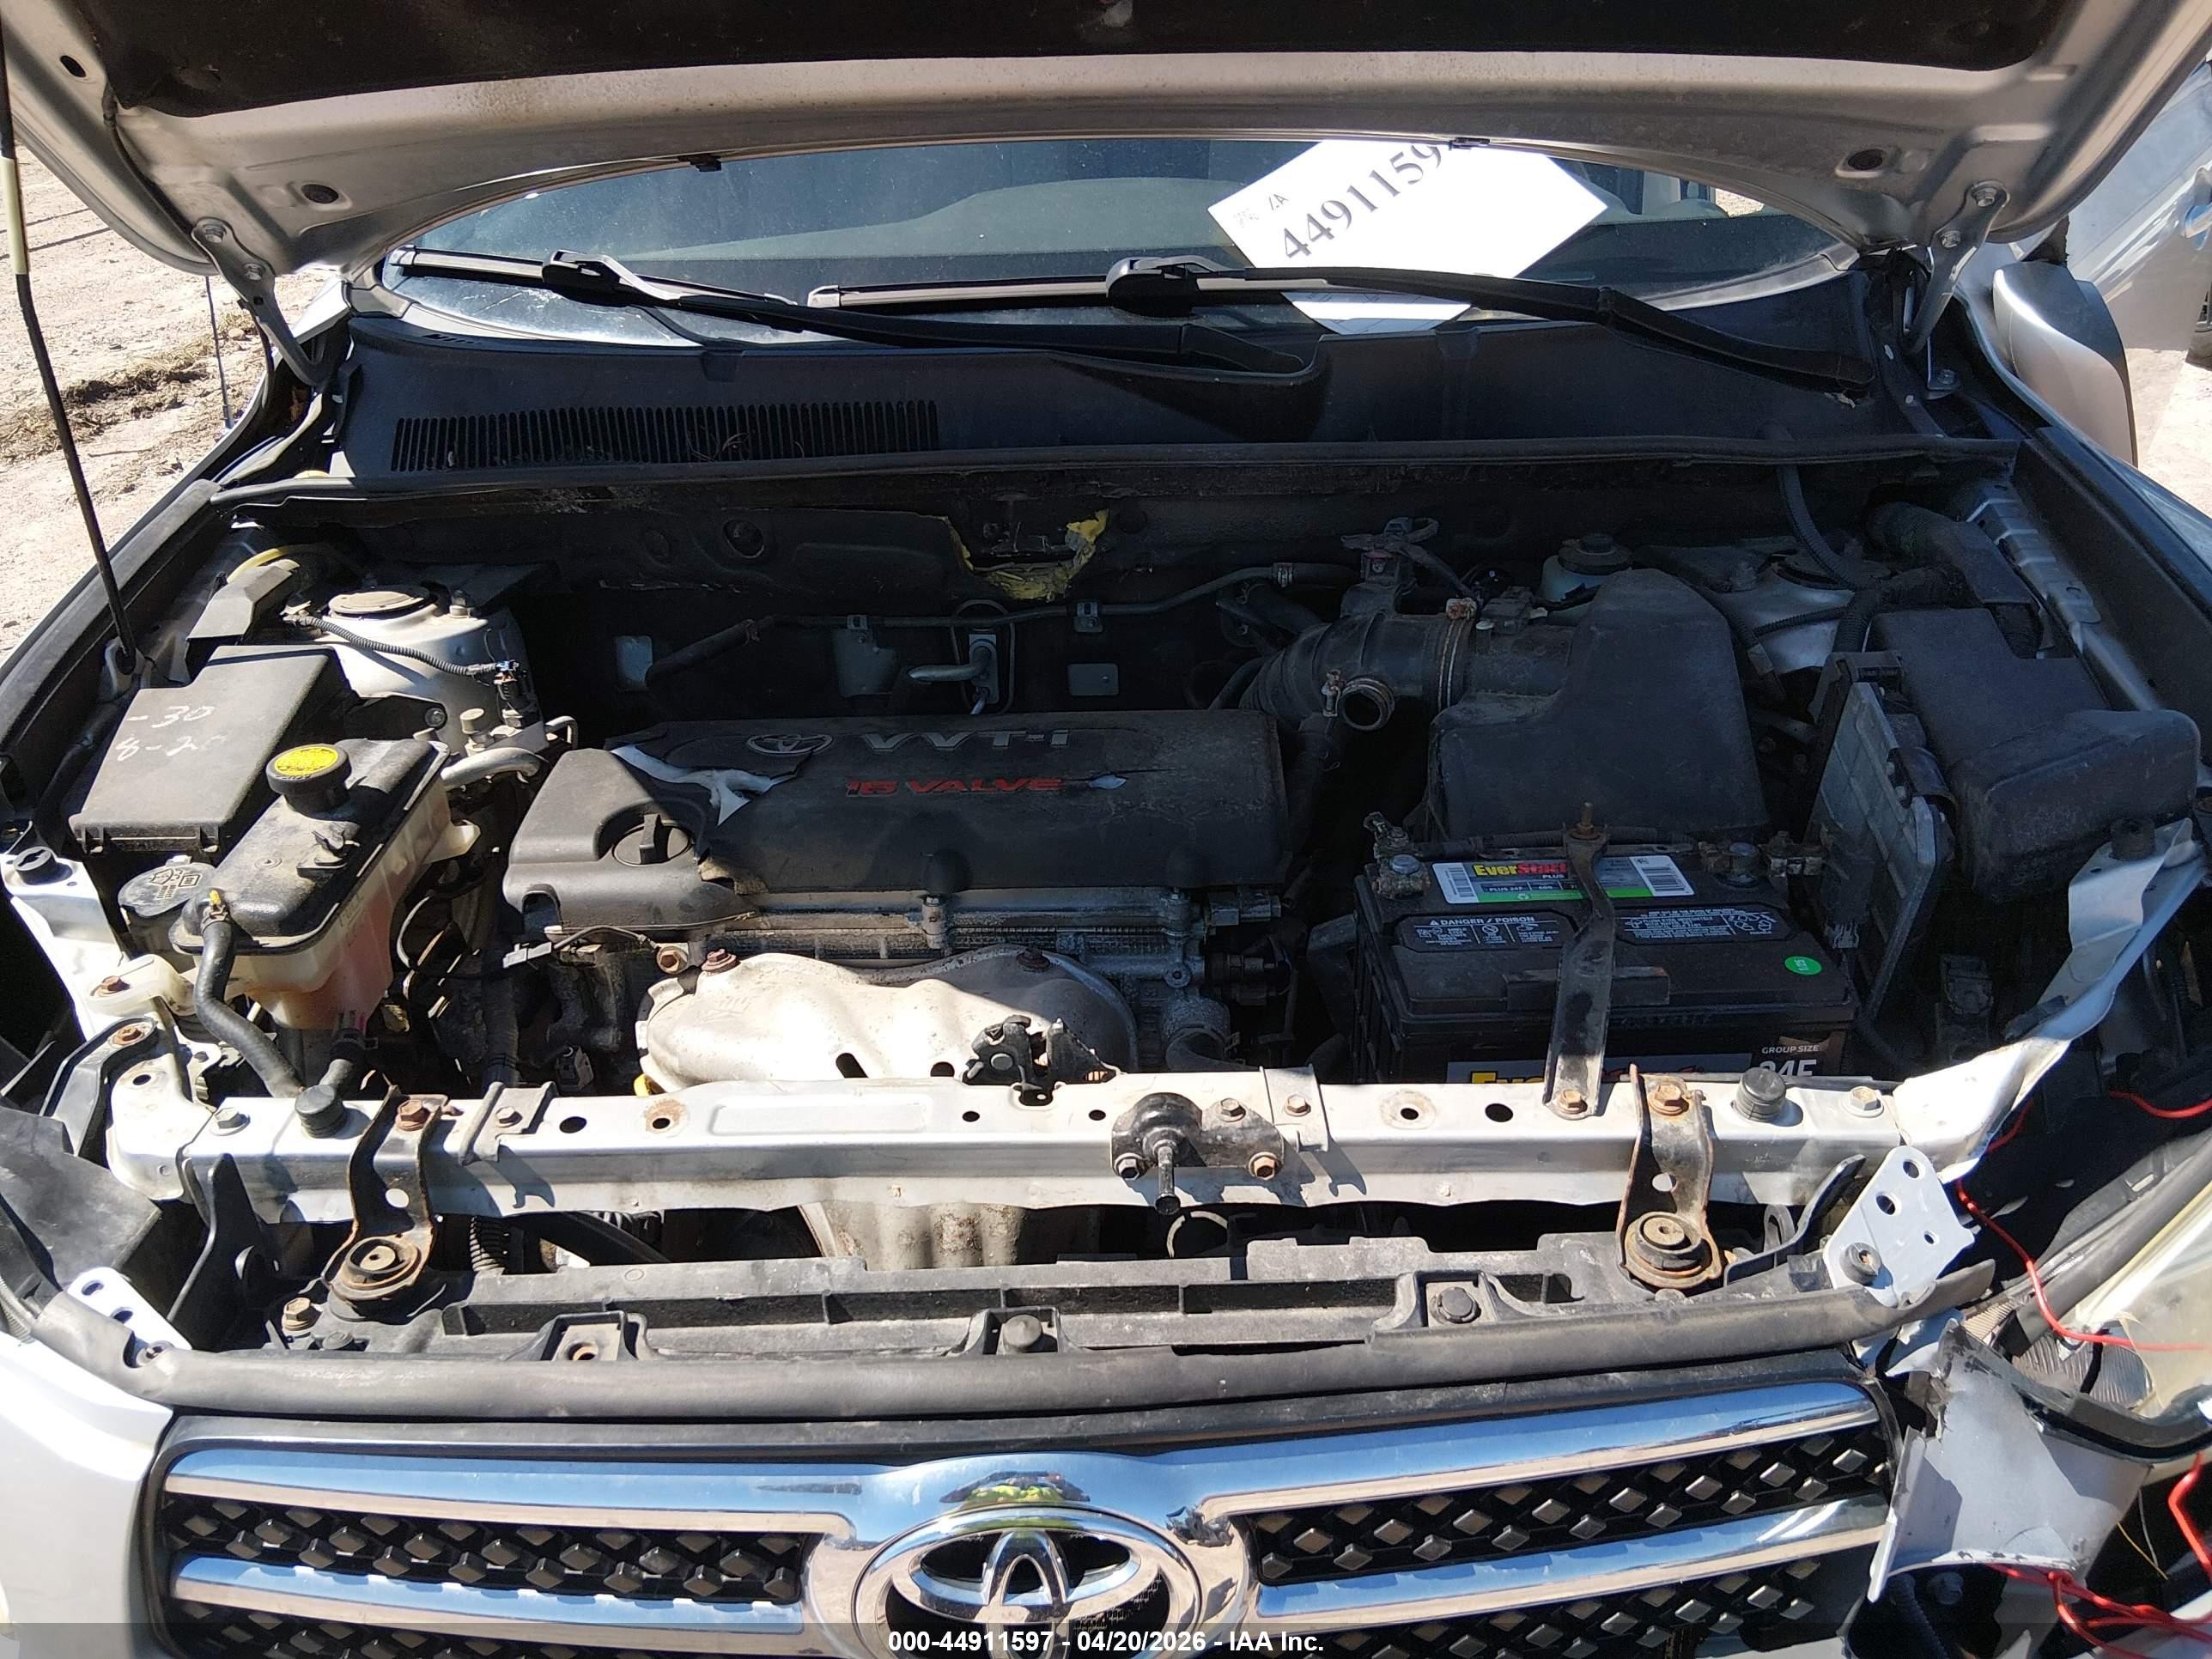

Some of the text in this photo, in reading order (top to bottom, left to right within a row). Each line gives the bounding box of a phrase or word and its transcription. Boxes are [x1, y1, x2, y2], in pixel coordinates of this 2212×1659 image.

[847, 778, 1061, 797] 16 VALVE
[1473, 862, 1567, 876] EverStart
[1761, 1044, 1820, 1054] GROUP SIZE
